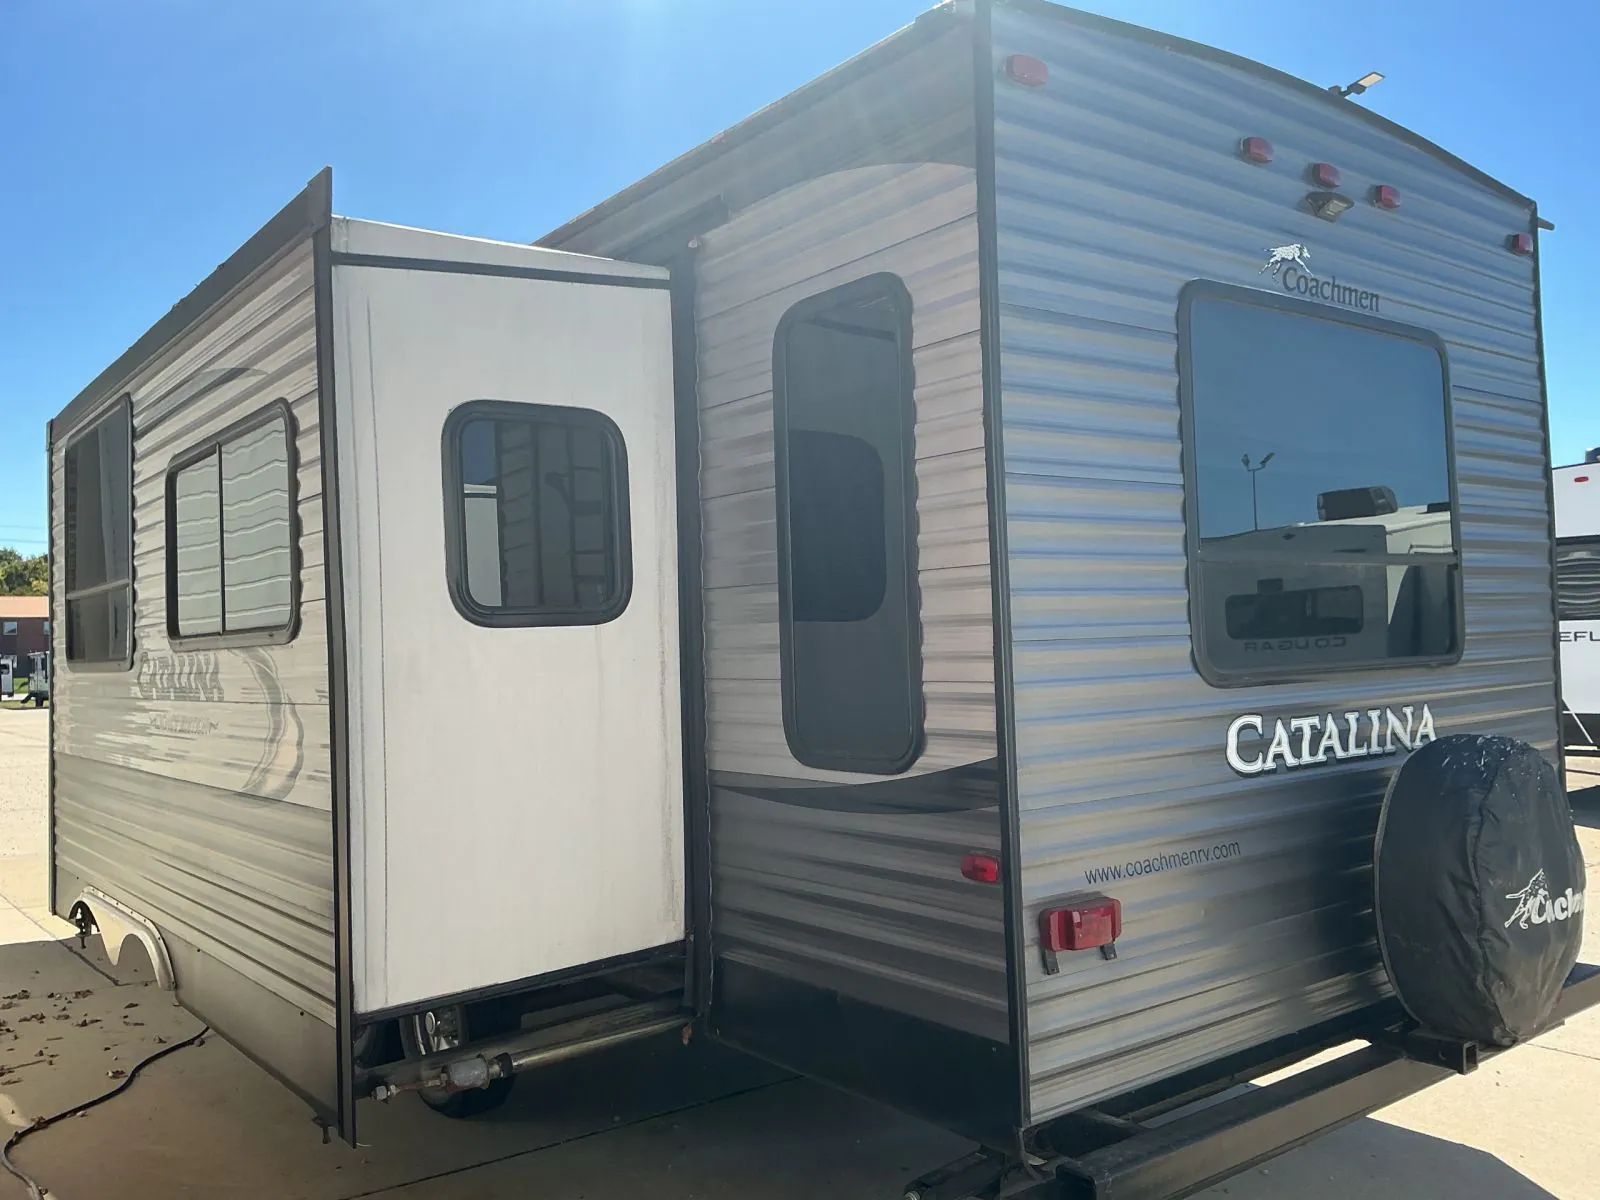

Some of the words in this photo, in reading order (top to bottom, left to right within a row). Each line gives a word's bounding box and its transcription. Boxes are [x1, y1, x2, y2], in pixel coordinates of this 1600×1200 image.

[1282, 266, 1380, 313] Coachmen
[1225, 703, 1437, 777] CATALINA
[1084, 841, 1241, 885] www.coachmenrv.com
